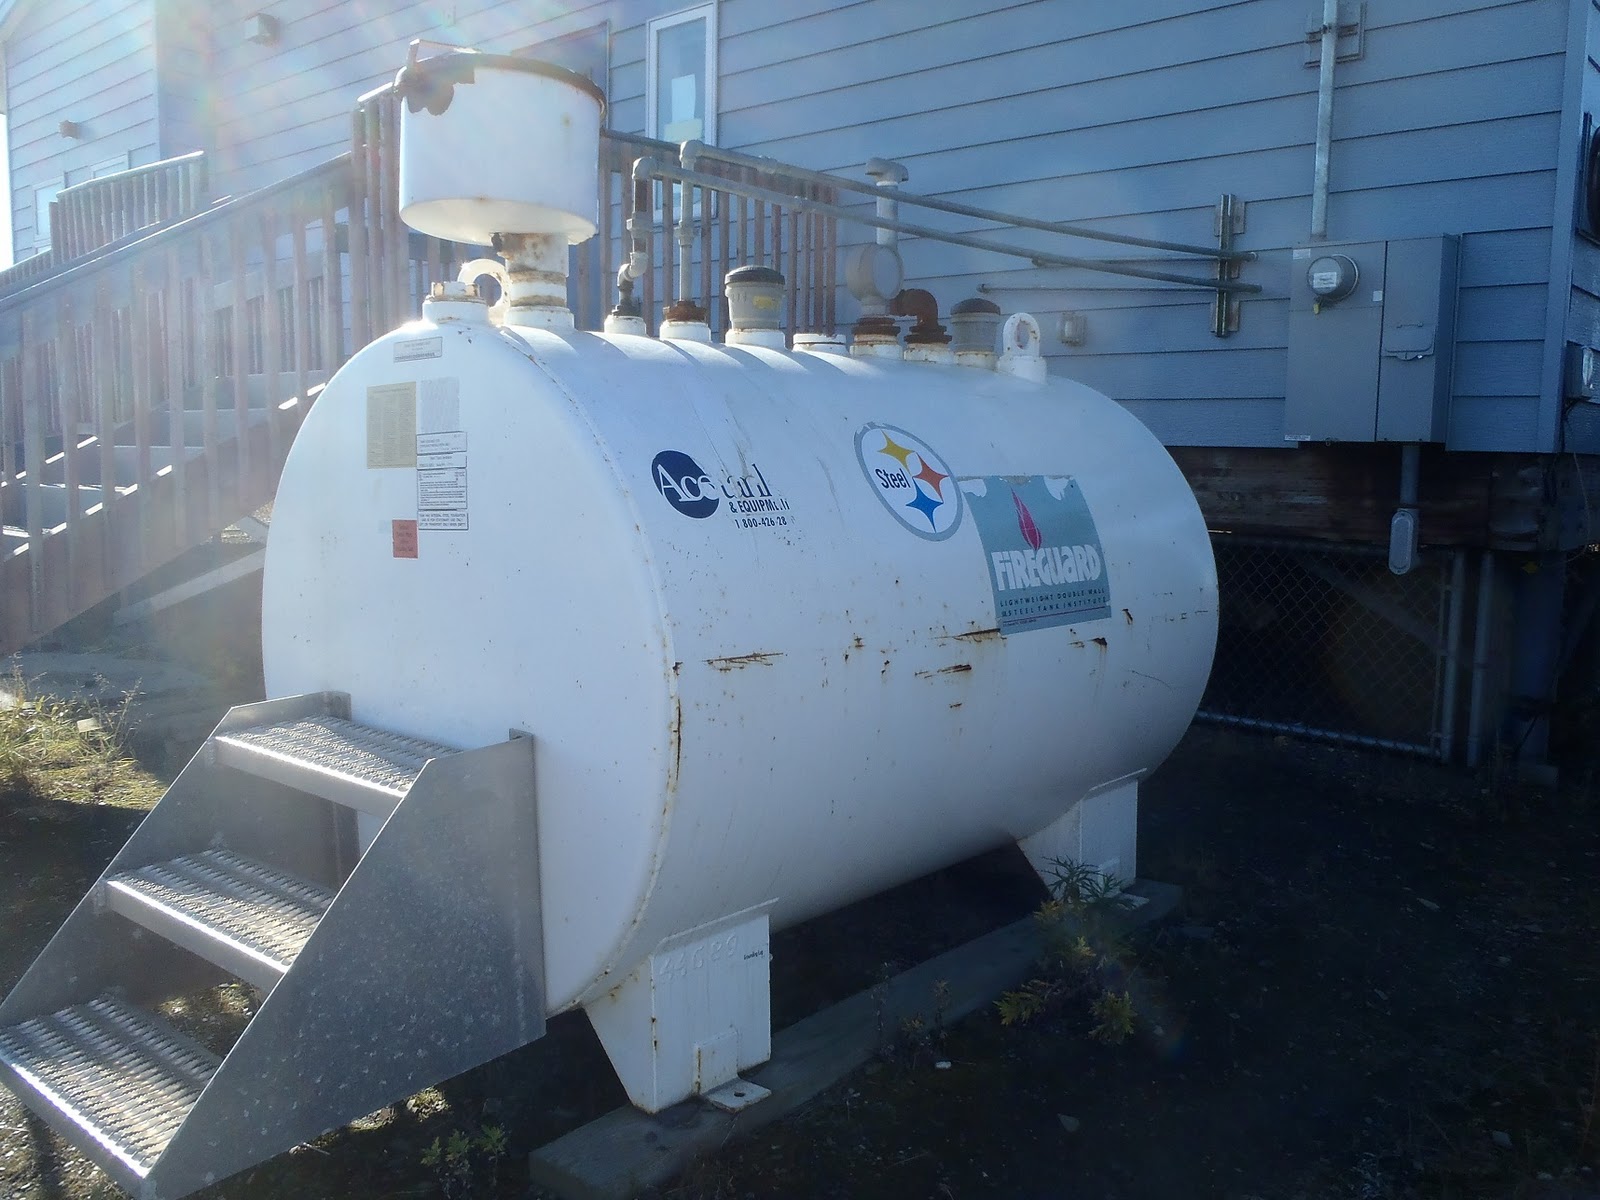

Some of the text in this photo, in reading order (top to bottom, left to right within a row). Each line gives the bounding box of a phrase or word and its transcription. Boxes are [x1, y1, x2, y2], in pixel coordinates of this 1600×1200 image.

[875, 468, 911, 489] Steel
[1000, 587, 1105, 607] LIGHTWEIGHT DOUBLE WALL
[1008, 608, 1034, 617] STEEL
[1037, 603, 1060, 612] TANK
[1063, 596, 1107, 609] INSTITUTE
